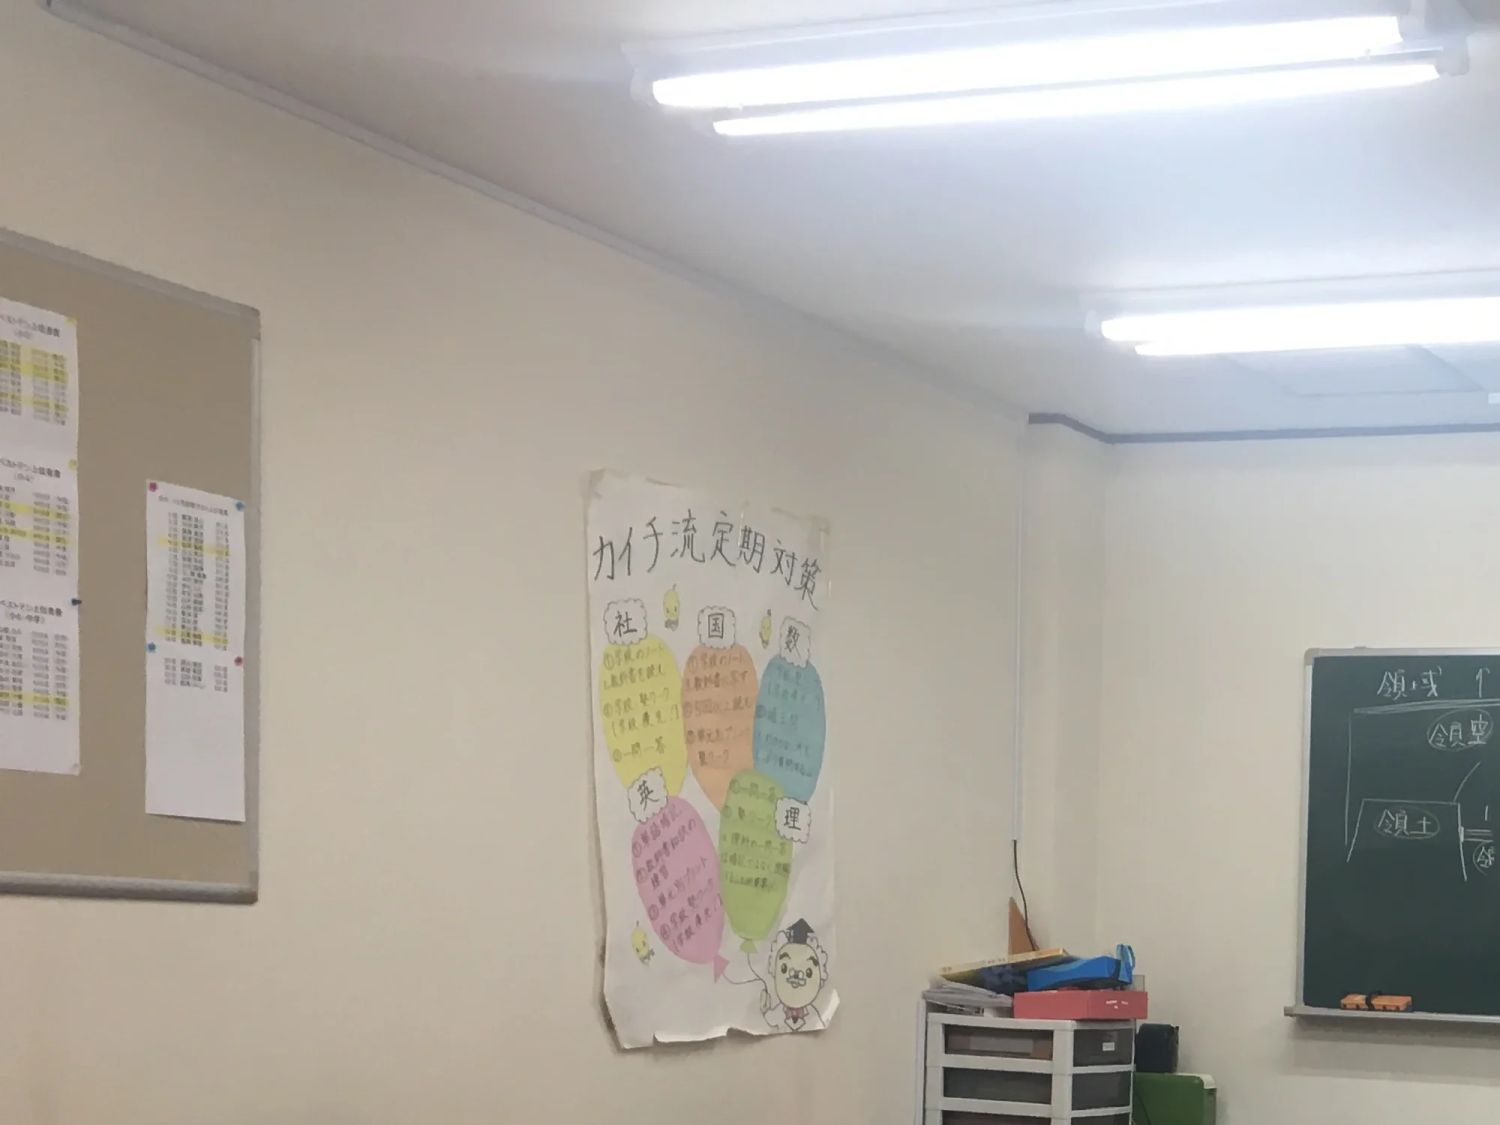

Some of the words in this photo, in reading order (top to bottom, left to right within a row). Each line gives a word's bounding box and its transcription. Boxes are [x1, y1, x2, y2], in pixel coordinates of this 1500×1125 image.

[592, 508, 822, 611] カイチ流定期対策
[613, 611, 637, 638] 社
[707, 613, 724, 639] 国
[784, 625, 803, 656] 数
[1428, 714, 1489, 748] 領空
[636, 779, 660, 811] 英
[784, 806, 802, 831] 理
[1377, 809, 1436, 837] 領土
